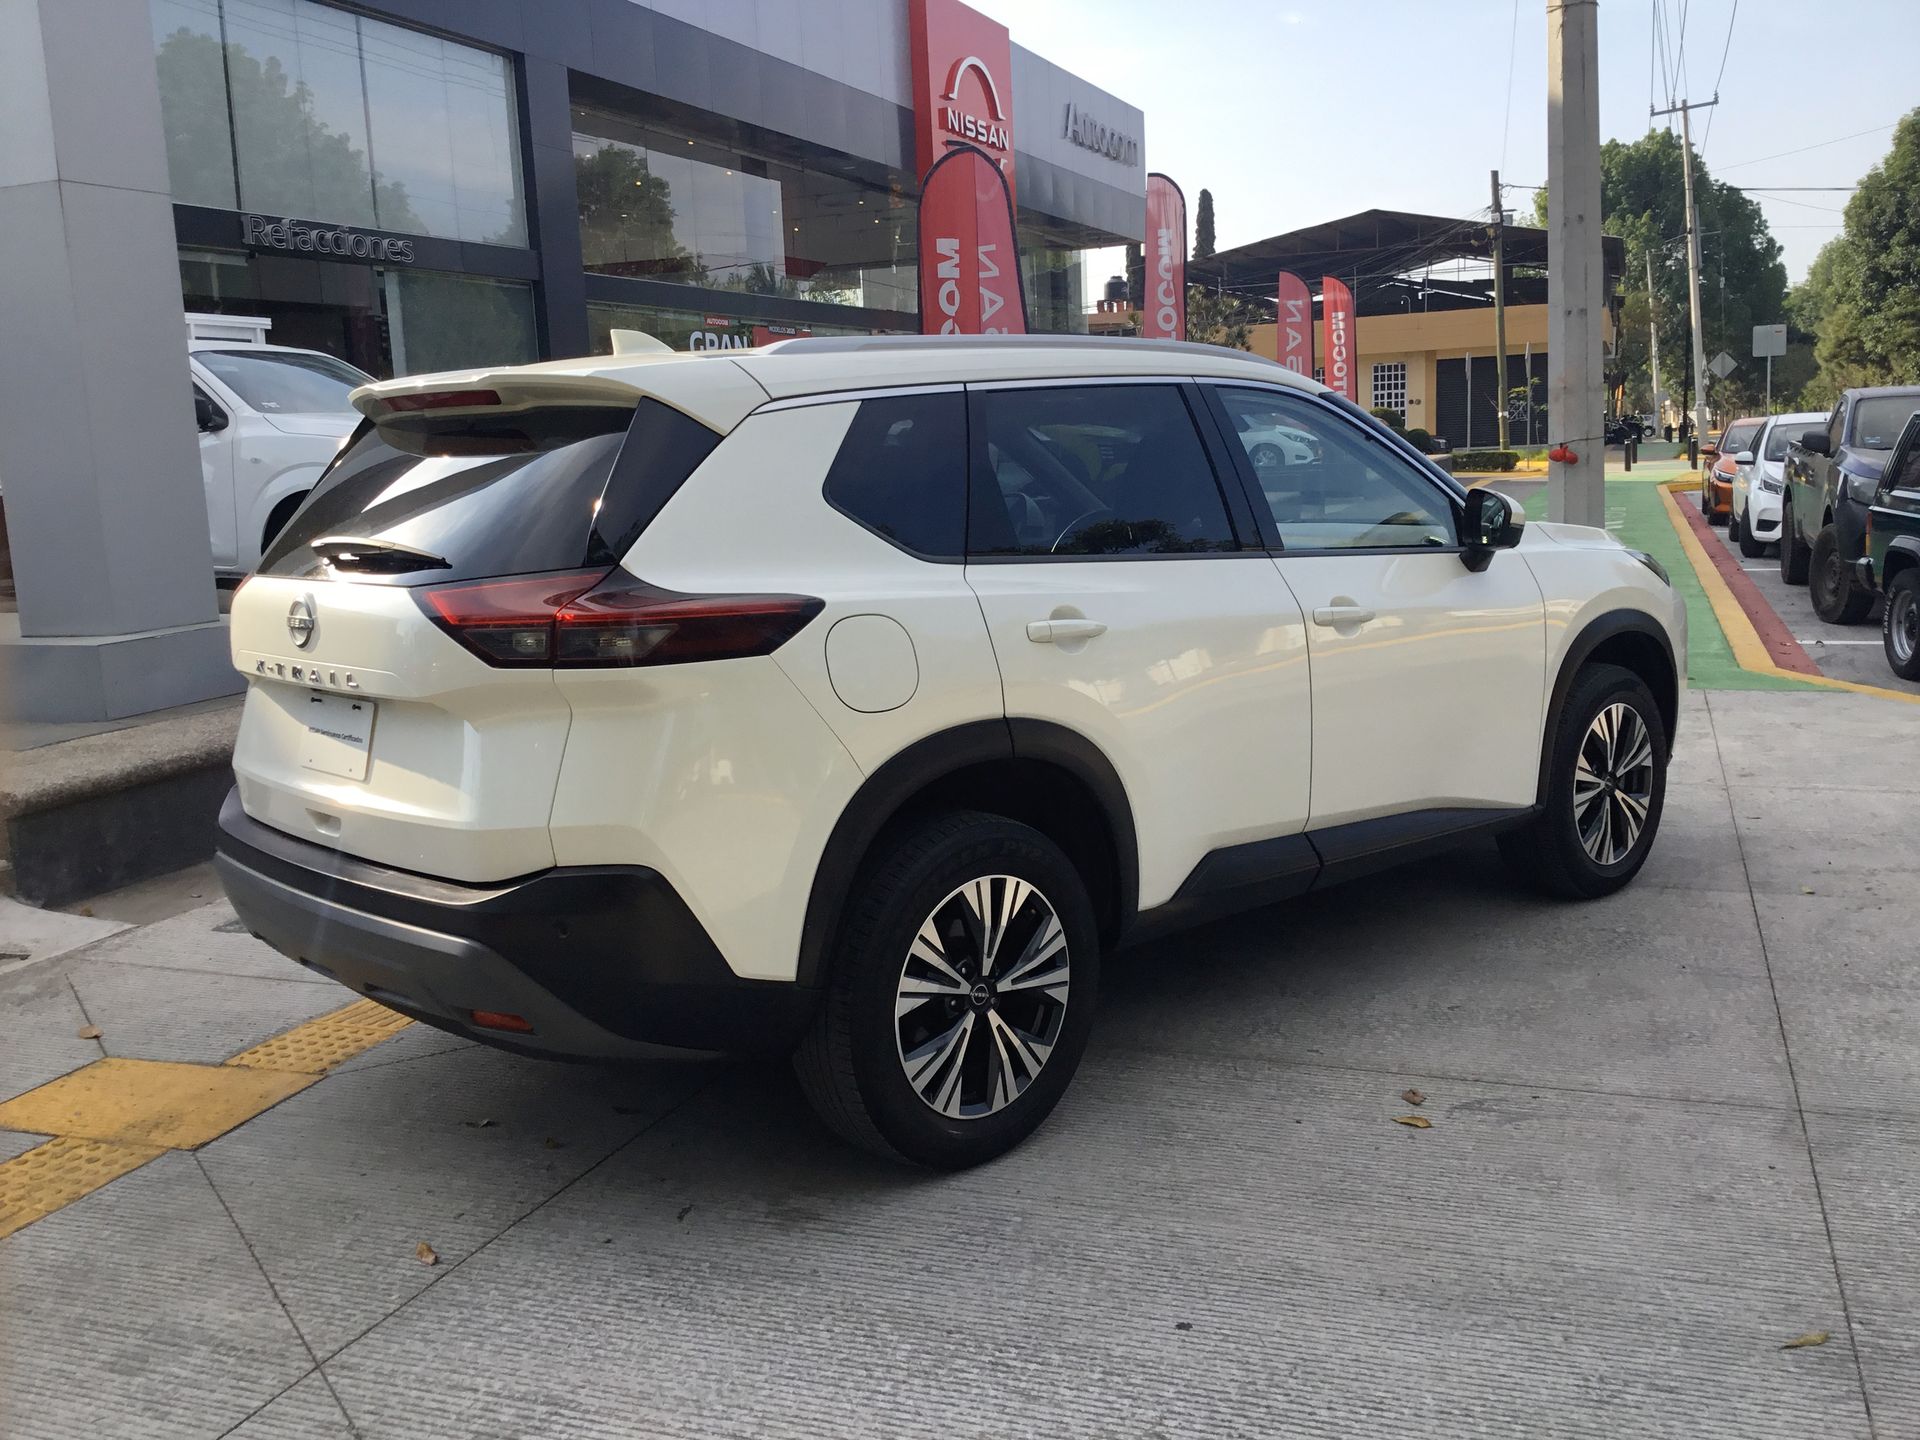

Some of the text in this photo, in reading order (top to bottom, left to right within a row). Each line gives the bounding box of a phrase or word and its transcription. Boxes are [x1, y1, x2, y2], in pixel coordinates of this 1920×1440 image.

[948, 107, 1009, 151] NISSAN
[1065, 102, 1138, 168] Autocom
[246, 215, 415, 263] Refacciones
[256, 659, 359, 688] X-TRAIL
